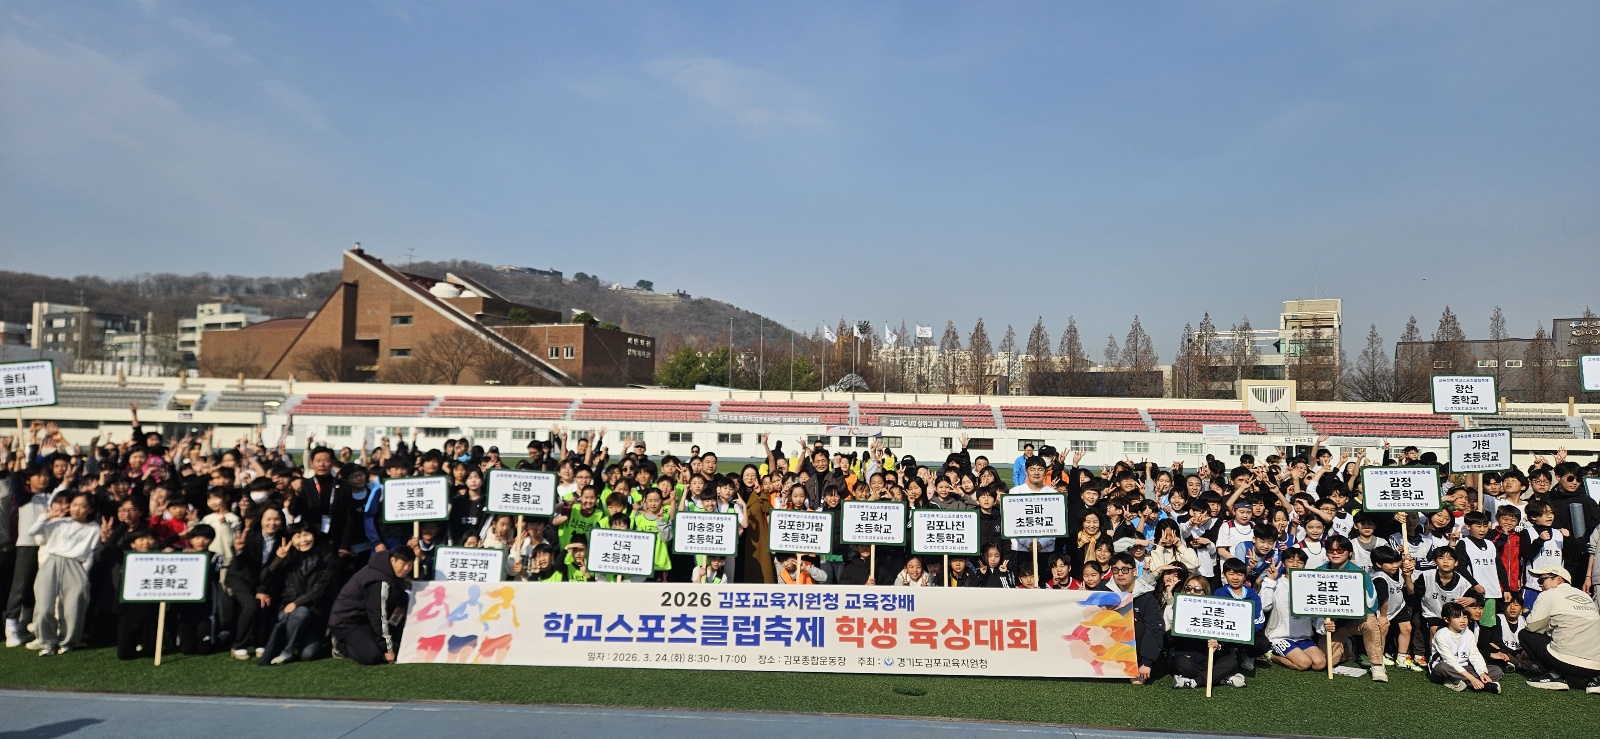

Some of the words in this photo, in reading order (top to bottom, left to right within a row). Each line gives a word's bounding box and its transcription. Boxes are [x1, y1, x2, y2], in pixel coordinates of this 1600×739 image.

[1455, 384, 1474, 393] 향산
[1451, 396, 1480, 404] 중학교
[1472, 440, 1490, 449] 가현
[1463, 452, 1499, 462] 초등학교
[512, 481, 532, 491] 신양
[1390, 477, 1411, 487] 감정
[501, 493, 540, 504] 초등학교
[1380, 490, 1424, 500] 초등학교
[397, 500, 434, 510] 초등학교
[1025, 504, 1044, 514] 금파
[860, 512, 888, 521] 김포서
[778, 520, 824, 532] 김포한가람
[926, 521, 965, 531] 김포나진
[1016, 517, 1054, 527] 초등학교
[687, 522, 724, 533] 마송중앙
[855, 524, 892, 534] 초등학교
[686, 534, 724, 544] 초등학교
[782, 533, 818, 543] 초등학교
[926, 533, 965, 543] 초등학교
[613, 540, 631, 551] 신곡
[601, 552, 640, 564] 초등학교
[450, 558, 489, 569] 김포구래
[154, 564, 177, 575] 사우
[446, 571, 486, 582] 초등학교
[140, 579, 188, 589] 초등학교
[1317, 581, 1338, 592] 걸포
[661, 592, 712, 607] 2026
[718, 592, 839, 611] 김포교육지원청
[844, 593, 915, 612] 교육장배
[1306, 594, 1350, 606] 초등학교
[1202, 606, 1225, 617] 고촌
[1190, 617, 1236, 630] 초등학교
[543, 612, 824, 648] 학교스포츠클럽축제
[836, 616, 898, 650] 학생
[908, 617, 1038, 651] 육상대회
[588, 652, 605, 662] 일자
[612, 653, 640, 662] 2026.
[643, 653, 652, 662] 3.
[655, 653, 685, 663] 24.(화)
[688, 654, 747, 664] 8:30~17:00
[758, 655, 776, 664] 장소
[784, 656, 846, 666] 김포종합운동장
[857, 657, 875, 666] 주최
[897, 658, 988, 669] 경기도김포교육지원청
